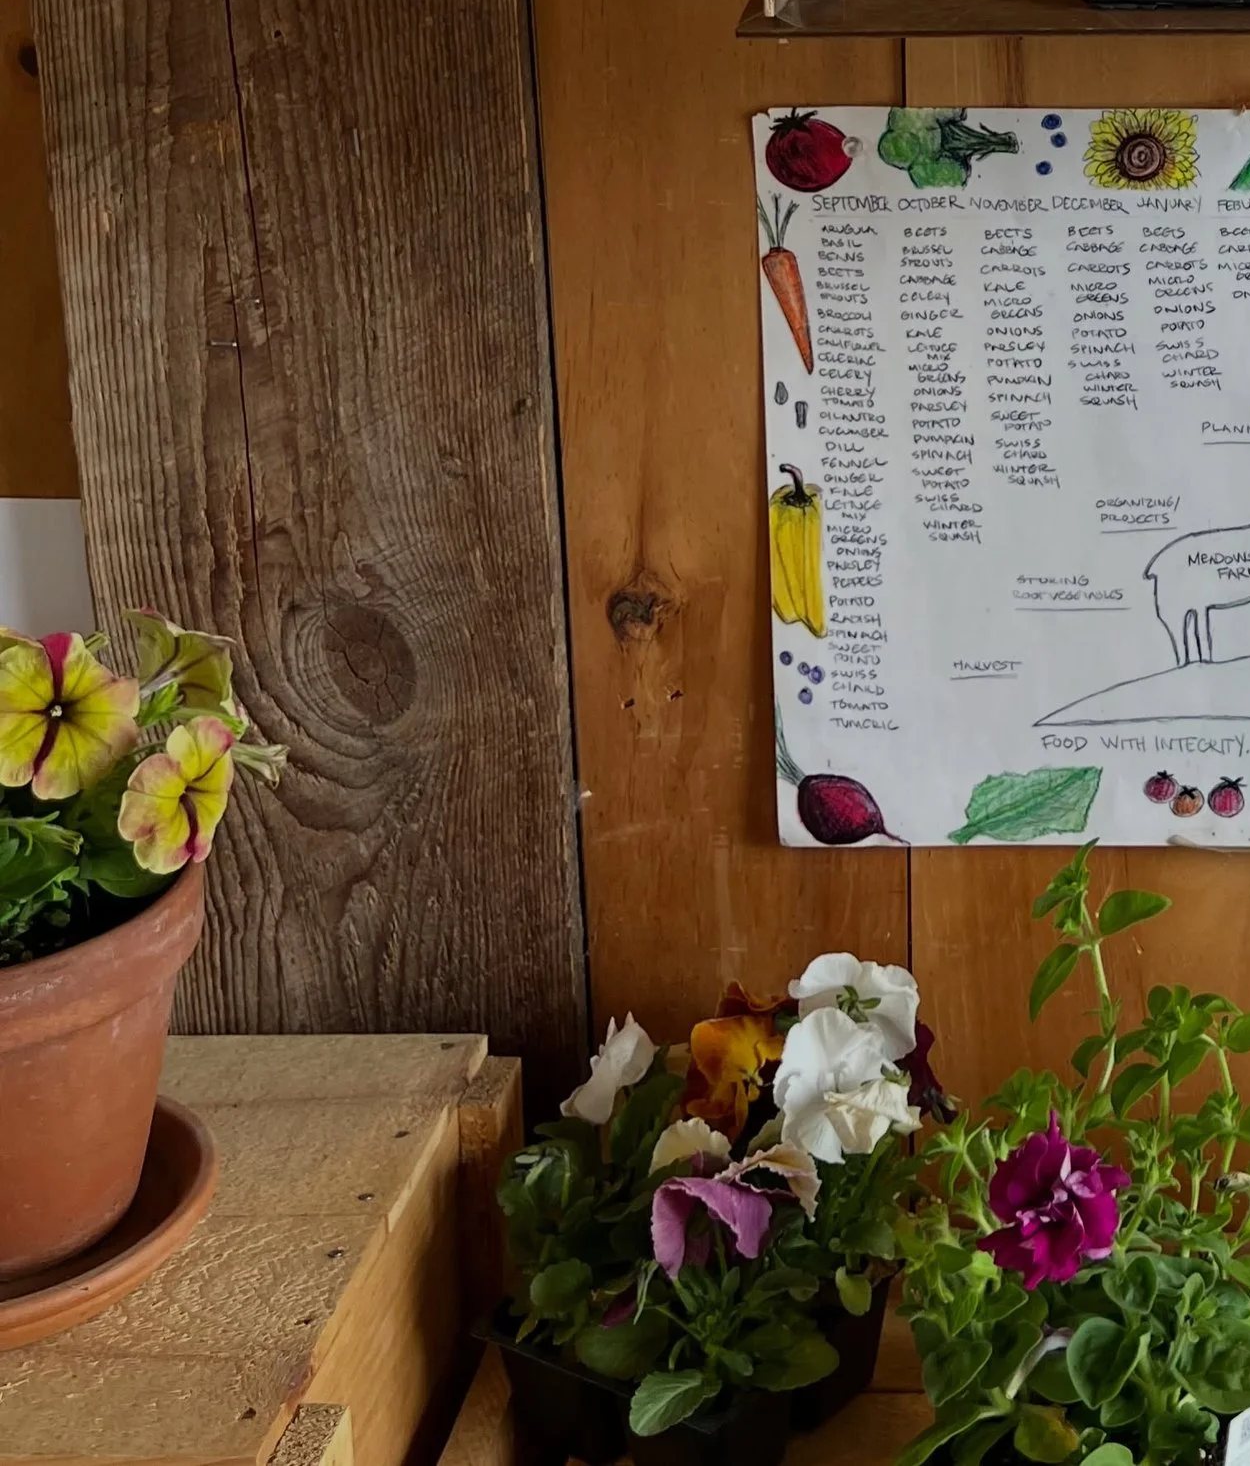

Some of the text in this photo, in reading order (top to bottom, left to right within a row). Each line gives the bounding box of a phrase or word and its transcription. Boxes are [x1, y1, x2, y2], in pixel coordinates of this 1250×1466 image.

[898, 195, 965, 213] OCTOBER
[970, 196, 1049, 212] NOVEMBER
[1052, 195, 1129, 214] DECEMBER
[1137, 196, 1201, 213] JANUARY
[1068, 225, 1113, 237] BEETS
[1066, 242, 1125, 253] CABBAGE
[980, 264, 1046, 276] CARROTS
[1067, 263, 1131, 275] CARROTS
[1146, 260, 1208, 270] CARROTS
[984, 282, 1025, 292] KALE
[984, 297, 1031, 307] MICRO
[1154, 301, 1216, 315] ONIONS
[1073, 311, 1124, 322] ONIONS
[906, 327, 943, 338] KALE
[987, 326, 1043, 336] ONIONS
[1071, 344, 1136, 354] SPINACH
[819, 369, 871, 387] CELERY
[821, 386, 875, 399] CHERRY
[913, 388, 962, 396] ONIONS
[911, 401, 967, 412] PARSLEY
[1080, 395, 1138, 410] SQUASH
[912, 418, 961, 429] POTATO
[825, 442, 864, 452] DILL
[912, 449, 972, 464] SPINACH
[1100, 512, 1170, 524] PROJECTS
[953, 660, 1022, 671] HARVEST
[1041, 735, 1088, 752] FOOD
[1100, 735, 1147, 753] WITH
